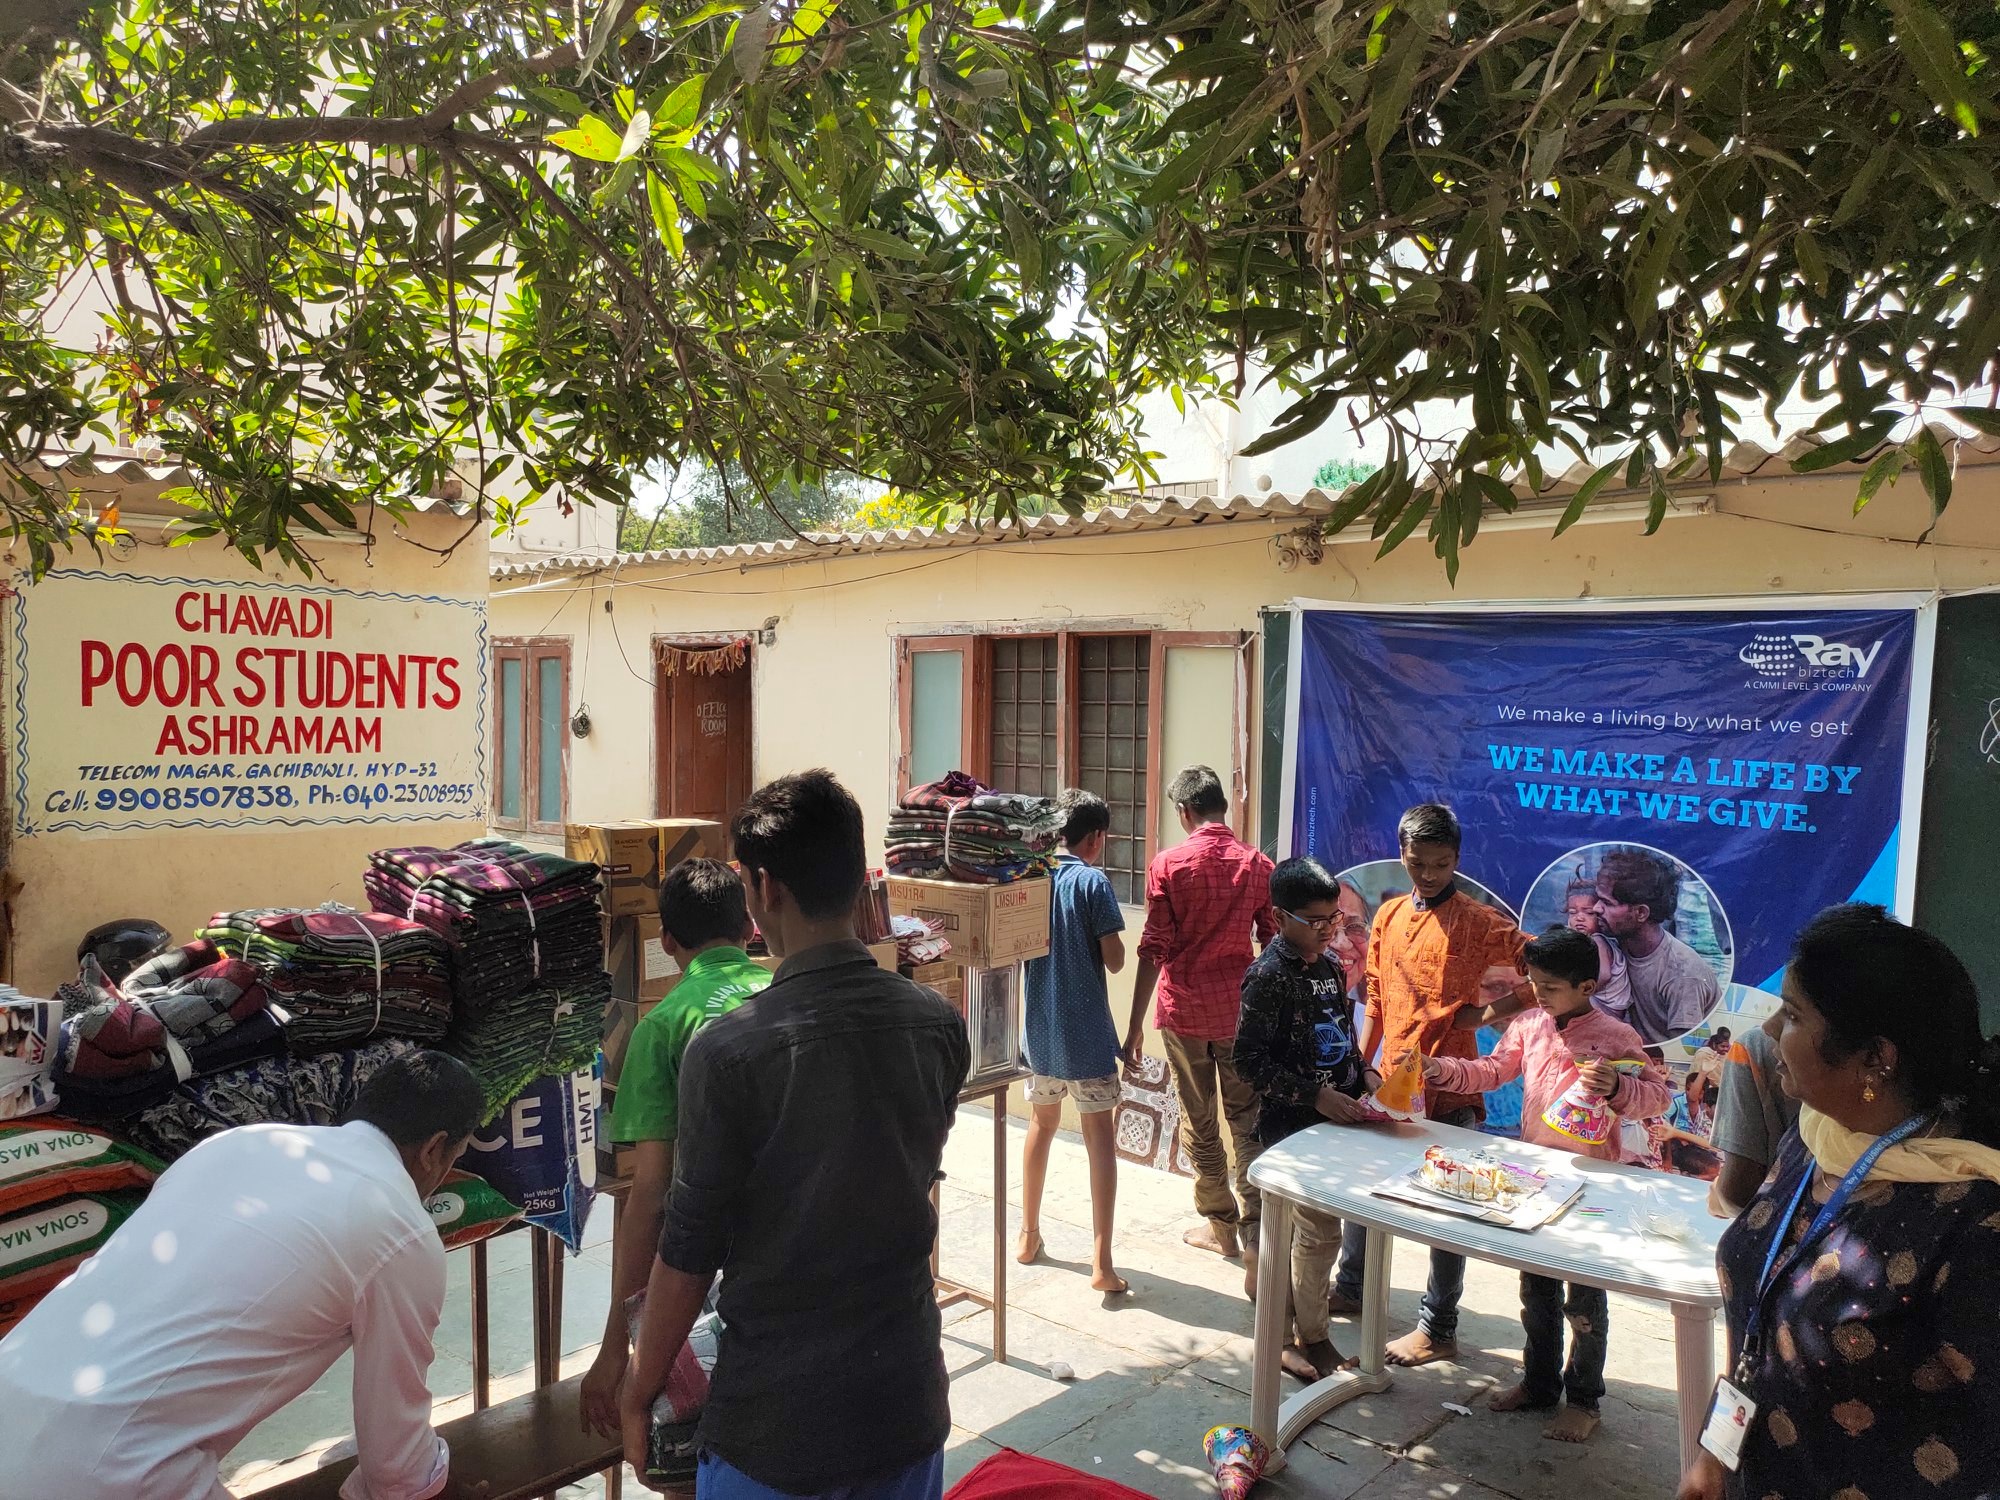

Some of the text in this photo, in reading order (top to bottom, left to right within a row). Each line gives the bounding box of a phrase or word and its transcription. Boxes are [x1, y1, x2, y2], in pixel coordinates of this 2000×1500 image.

[175, 591, 332, 639] CHAVADI
[1790, 634, 1883, 678] Ray
[81, 640, 461, 710] POOR STUDENTS
[1744, 680, 1872, 692] A CMMI LEVEL 3 COMPANY
[1798, 666, 1854, 678] biztech
[155, 714, 382, 756] ASHRAMAM
[1497, 704, 1854, 738] We make a living by what we get.
[78, 764, 160, 781] TELECOM
[1487, 744, 1862, 795] WE MAKE A LIFE BY
[45, 789, 89, 813] Cell:
[94, 785, 299, 812] 9908507838,
[1515, 782, 1817, 834] WHAT WE GIVE.
[705, 984, 750, 1008] VIJAYA
[577, 1088, 593, 1144] HMT
[43, 1132, 94, 1152] SONA
[1856, 1161, 1870, 1175] RAY
[524, 1198, 556, 1210] 25Kg
[35, 1211, 89, 1237] SONA
